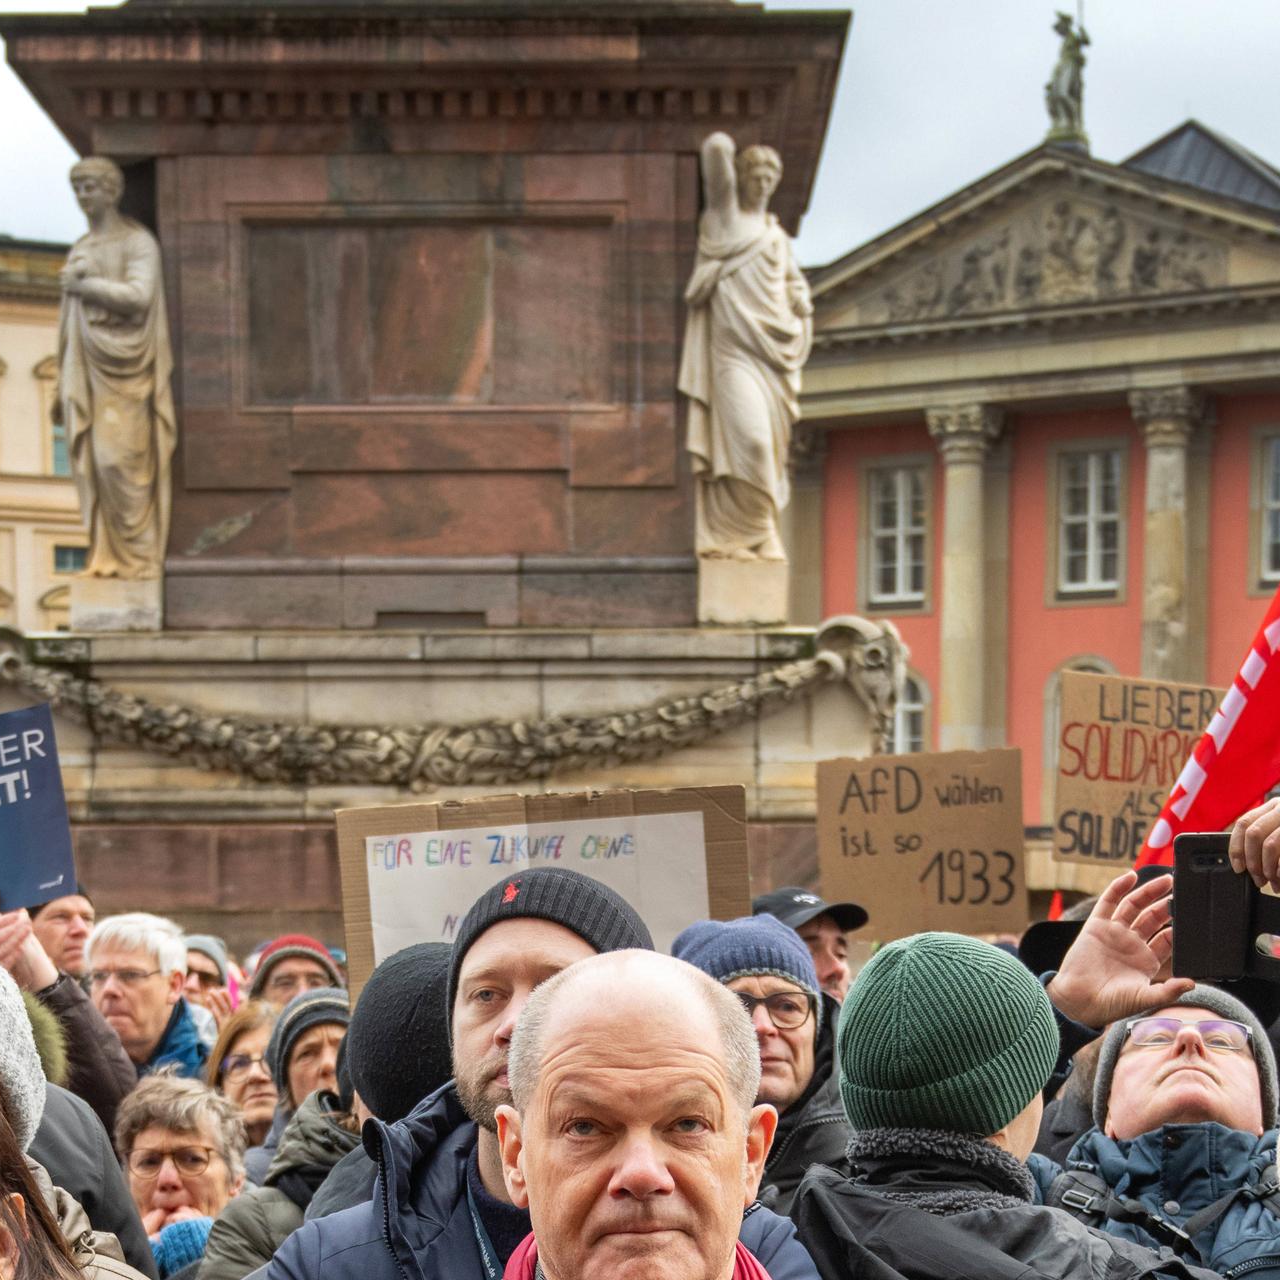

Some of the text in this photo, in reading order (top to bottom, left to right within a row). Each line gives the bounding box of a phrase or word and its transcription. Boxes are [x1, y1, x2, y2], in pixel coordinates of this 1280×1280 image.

[1099, 683, 1216, 731] LIEBER
[839, 766, 1004, 815] AfD wählen
[1121, 791, 1164, 817] ALS
[425, 838, 473, 867] EINE
[581, 833, 634, 860] OHNE
[839, 826, 923, 857] ist so
[918, 849, 1016, 906] 1933
